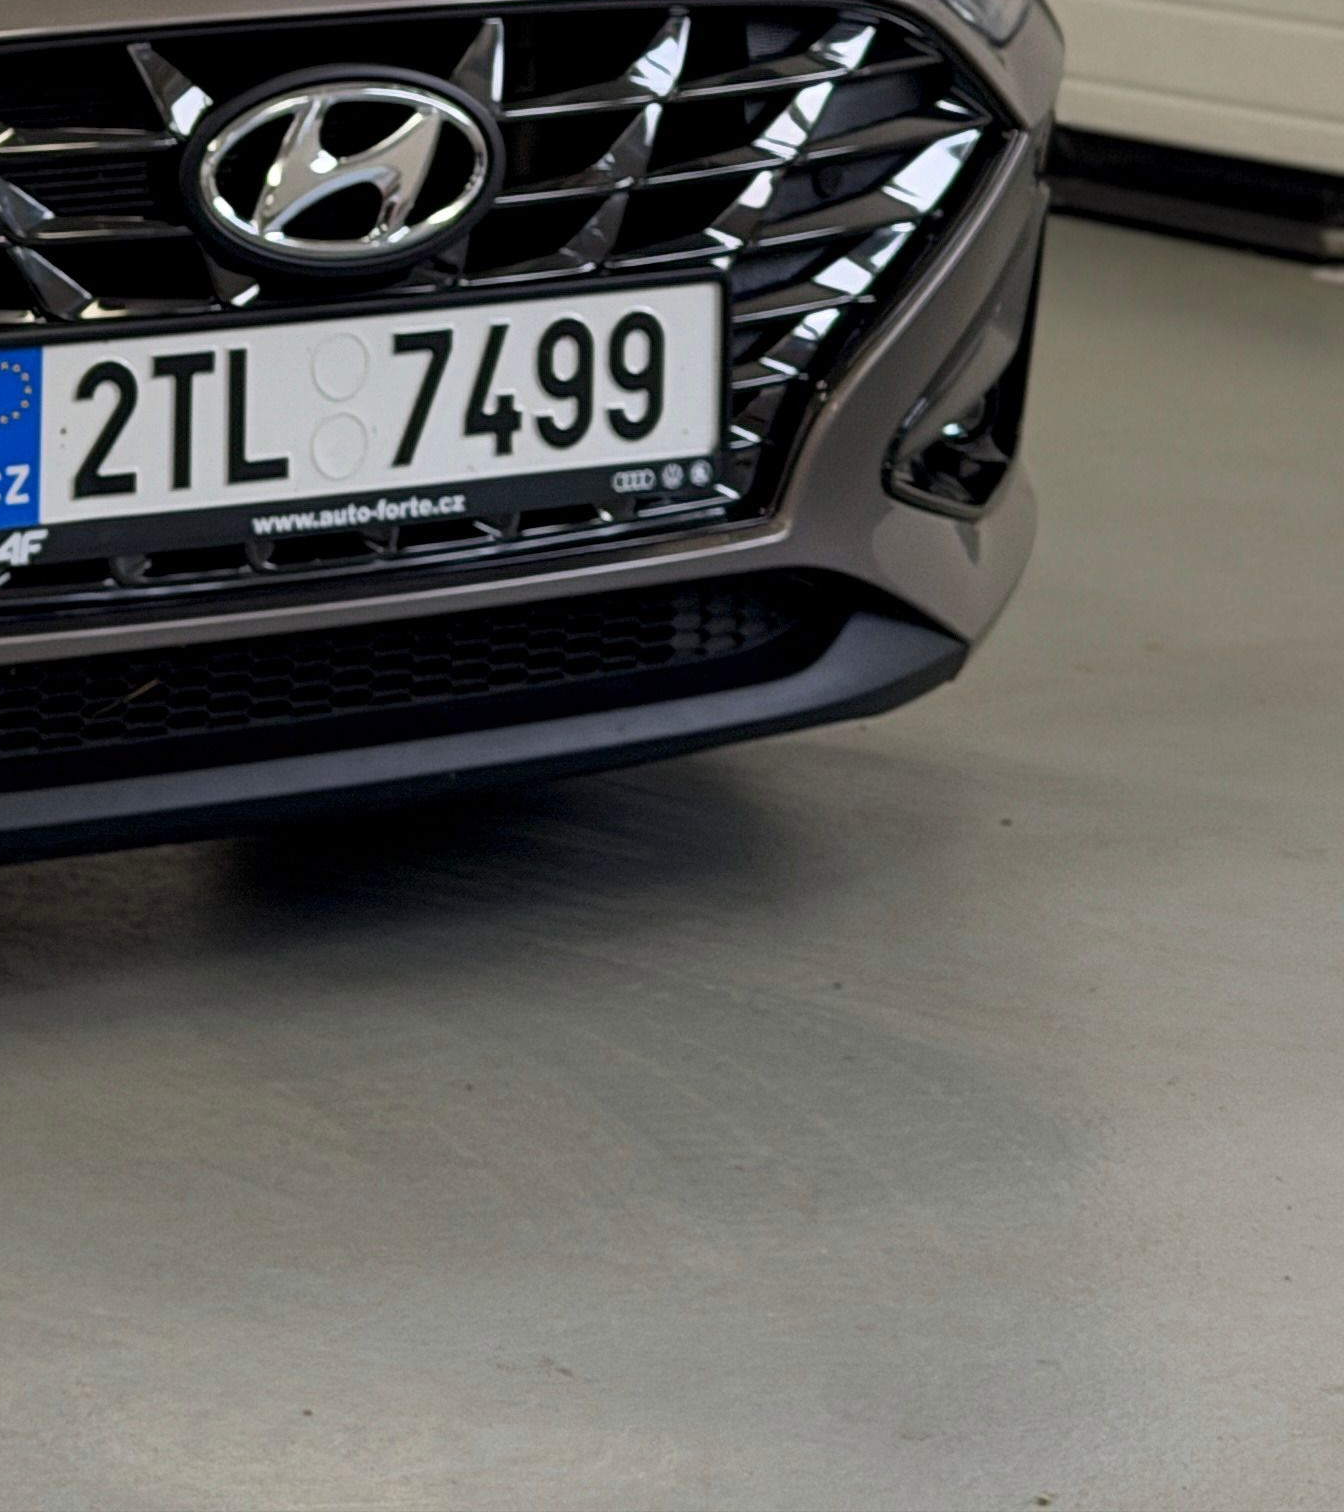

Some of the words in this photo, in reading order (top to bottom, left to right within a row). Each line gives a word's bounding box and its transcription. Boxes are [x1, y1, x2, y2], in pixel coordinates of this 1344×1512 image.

[71, 347, 290, 501] 2TL
[392, 309, 666, 468] 7499
[252, 493, 466, 536] www.auto-forte.cz
